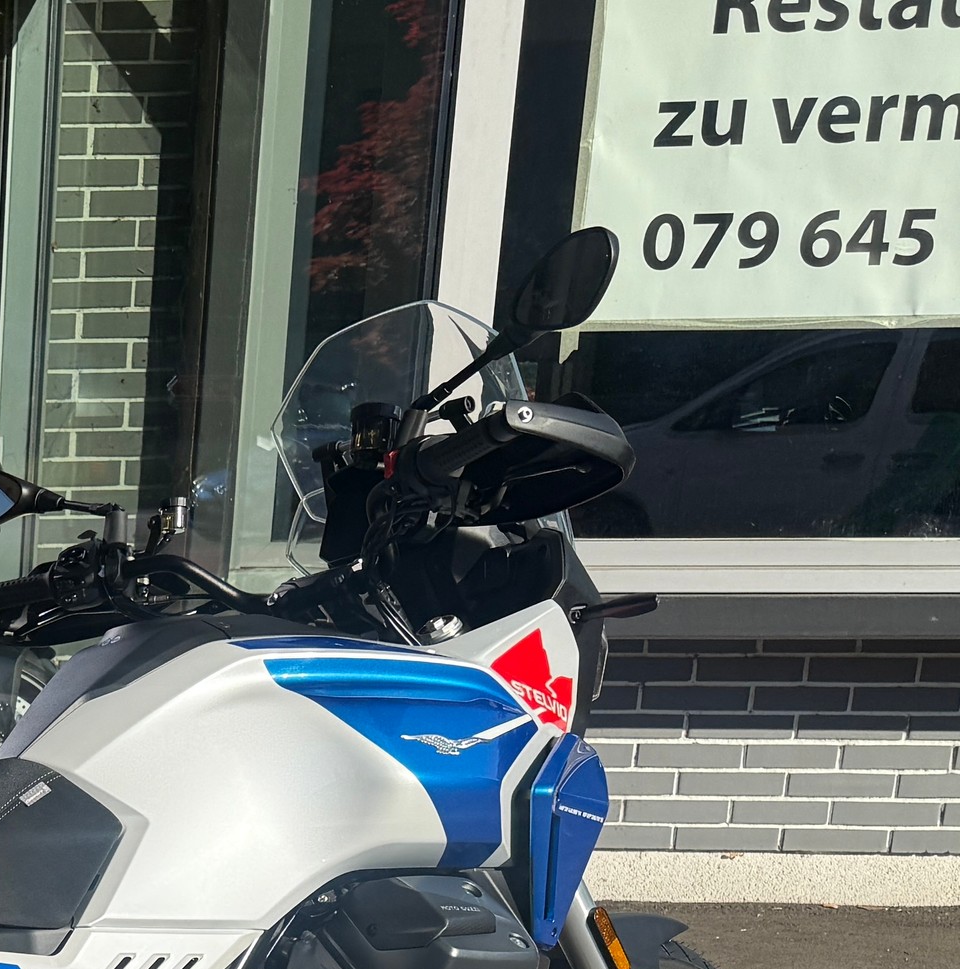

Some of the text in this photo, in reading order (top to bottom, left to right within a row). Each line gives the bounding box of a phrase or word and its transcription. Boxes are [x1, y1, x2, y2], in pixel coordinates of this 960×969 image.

[653, 92, 960, 148] zu verm
[642, 208, 937, 270] 079 645
[511, 680, 568, 722] STELVIO
